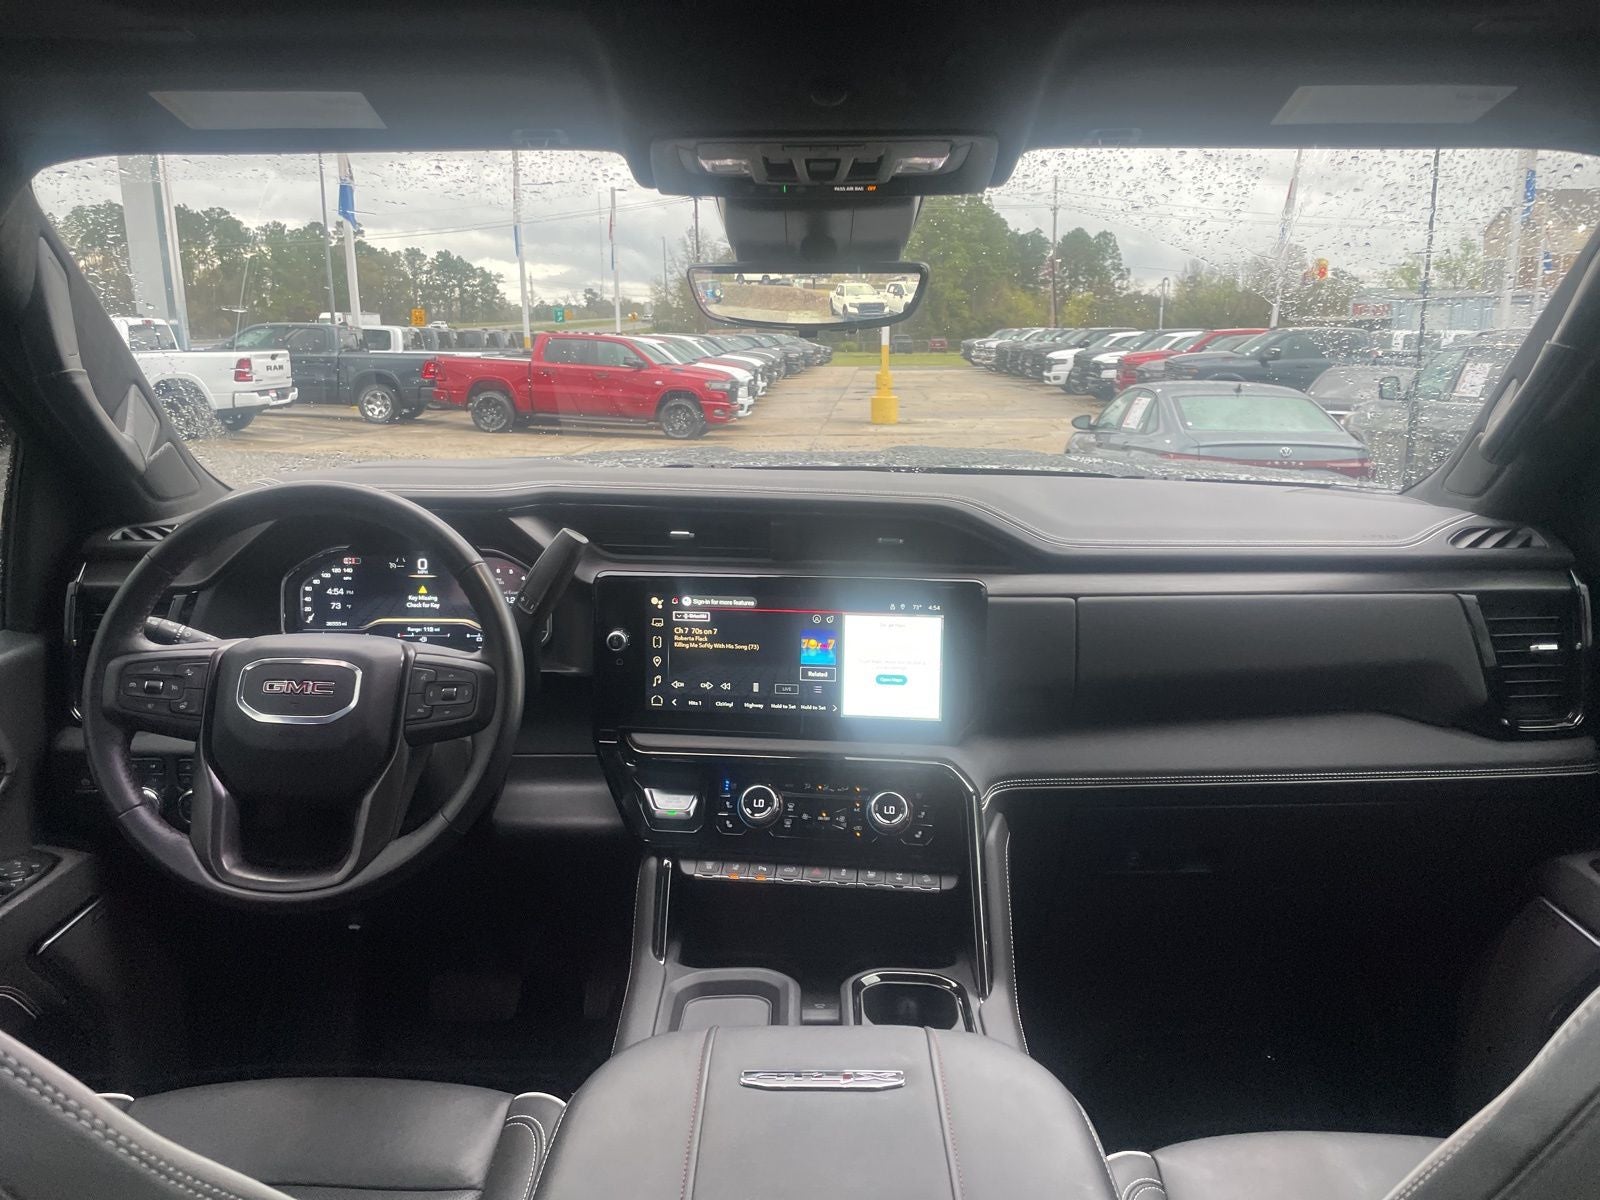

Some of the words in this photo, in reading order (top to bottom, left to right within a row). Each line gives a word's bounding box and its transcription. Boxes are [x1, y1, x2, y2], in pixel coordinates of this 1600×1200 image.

[417, 558, 428, 570] 0
[699, 642, 713, 650] Softly
[748, 643, 760, 651] (73)
[263, 680, 335, 694] GMC
[753, 799, 764, 807] LO
[884, 806, 895, 814] LO
